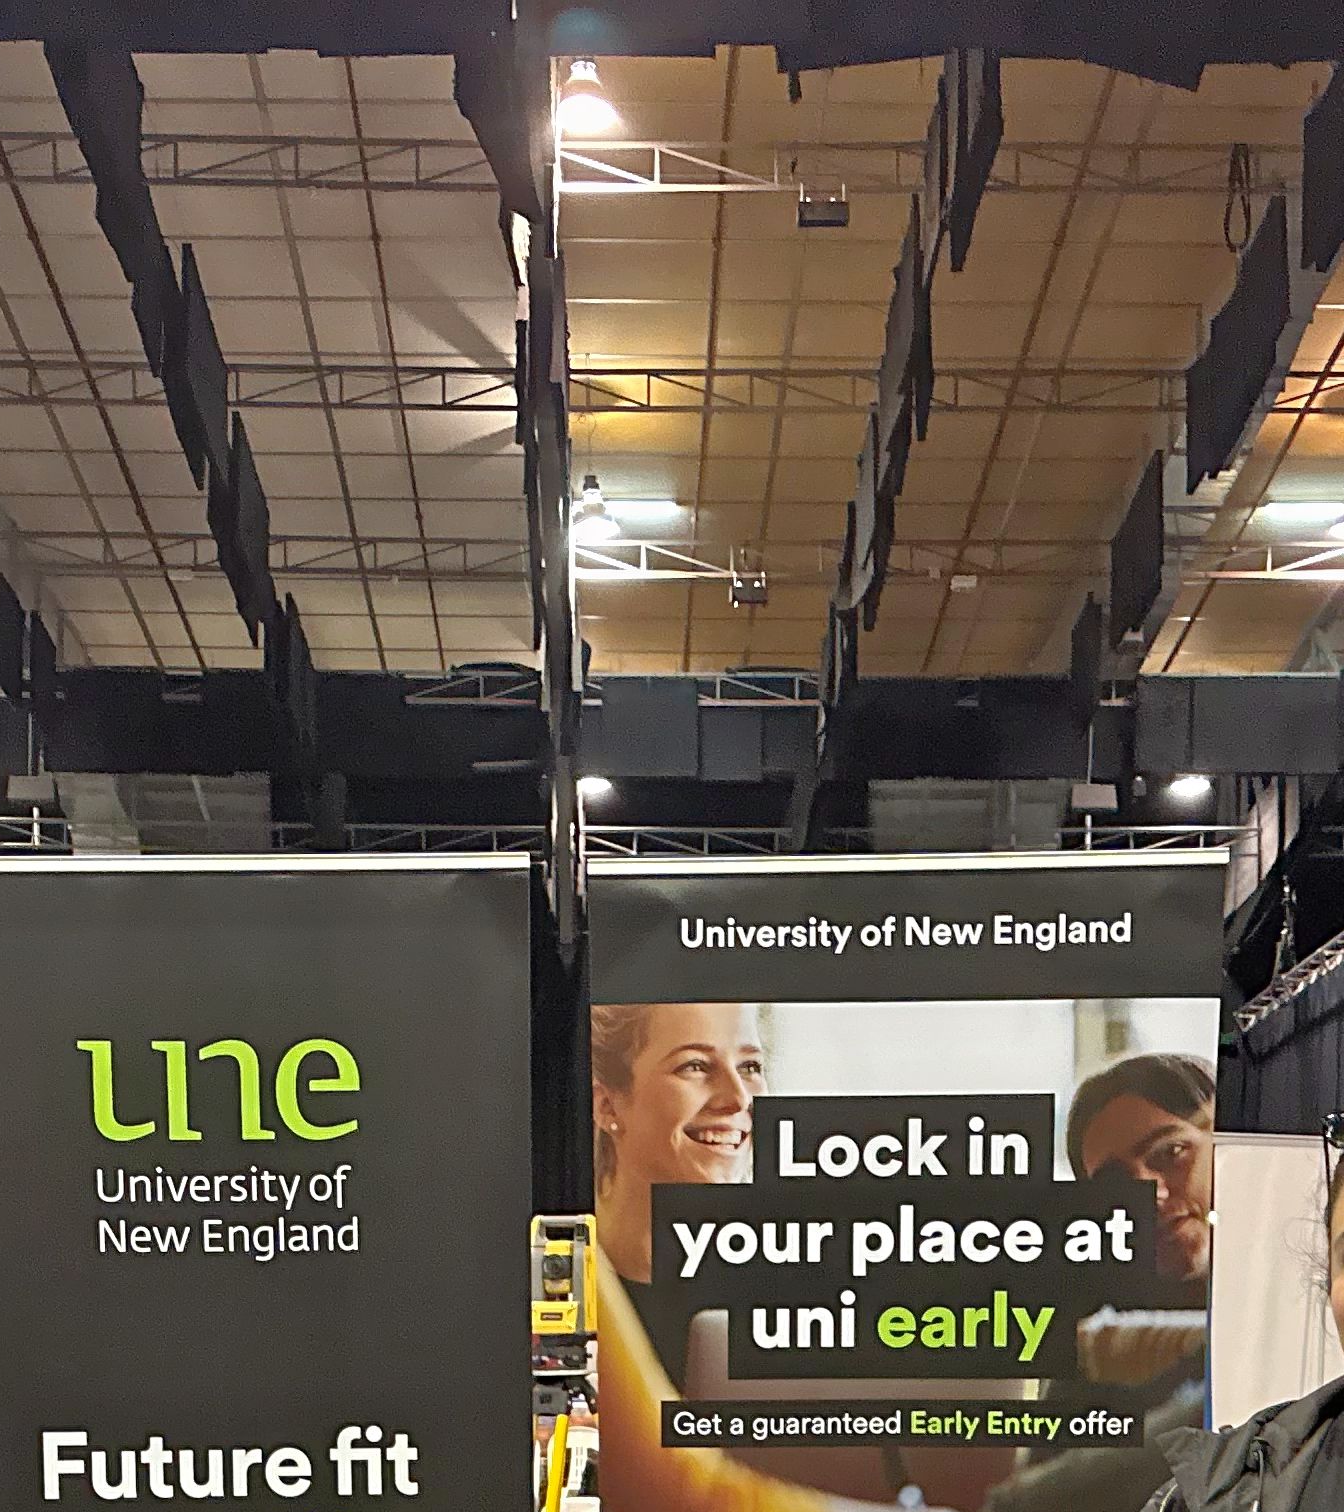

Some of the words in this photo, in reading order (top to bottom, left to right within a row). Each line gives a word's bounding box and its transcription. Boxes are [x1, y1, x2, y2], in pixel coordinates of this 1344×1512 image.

[680, 916, 853, 954] University
[860, 915, 897, 947] of
[905, 915, 983, 946] New
[993, 912, 1132, 951] England
[76, 1038, 362, 1142] une
[778, 1117, 948, 1177] Lock
[967, 1116, 1029, 1175] in
[96, 1165, 301, 1211] University
[309, 1164, 351, 1207] of
[98, 1218, 192, 1254] New
[203, 1217, 360, 1262] England
[672, 1218, 834, 1278] your
[852, 1203, 1044, 1278] place
[1064, 1207, 1134, 1261] at
[752, 1291, 856, 1349] uni
[876, 1290, 1055, 1361] early
[673, 1411, 723, 1436] Get
[729, 1418, 744, 1436] a
[752, 1411, 901, 1441] guaranteed
[910, 1410, 979, 1441] Early
[987, 1410, 1060, 1441] Entry
[1069, 1410, 1134, 1436] offer
[43, 1431, 312, 1501] Future
[330, 1426, 419, 1497] fit
